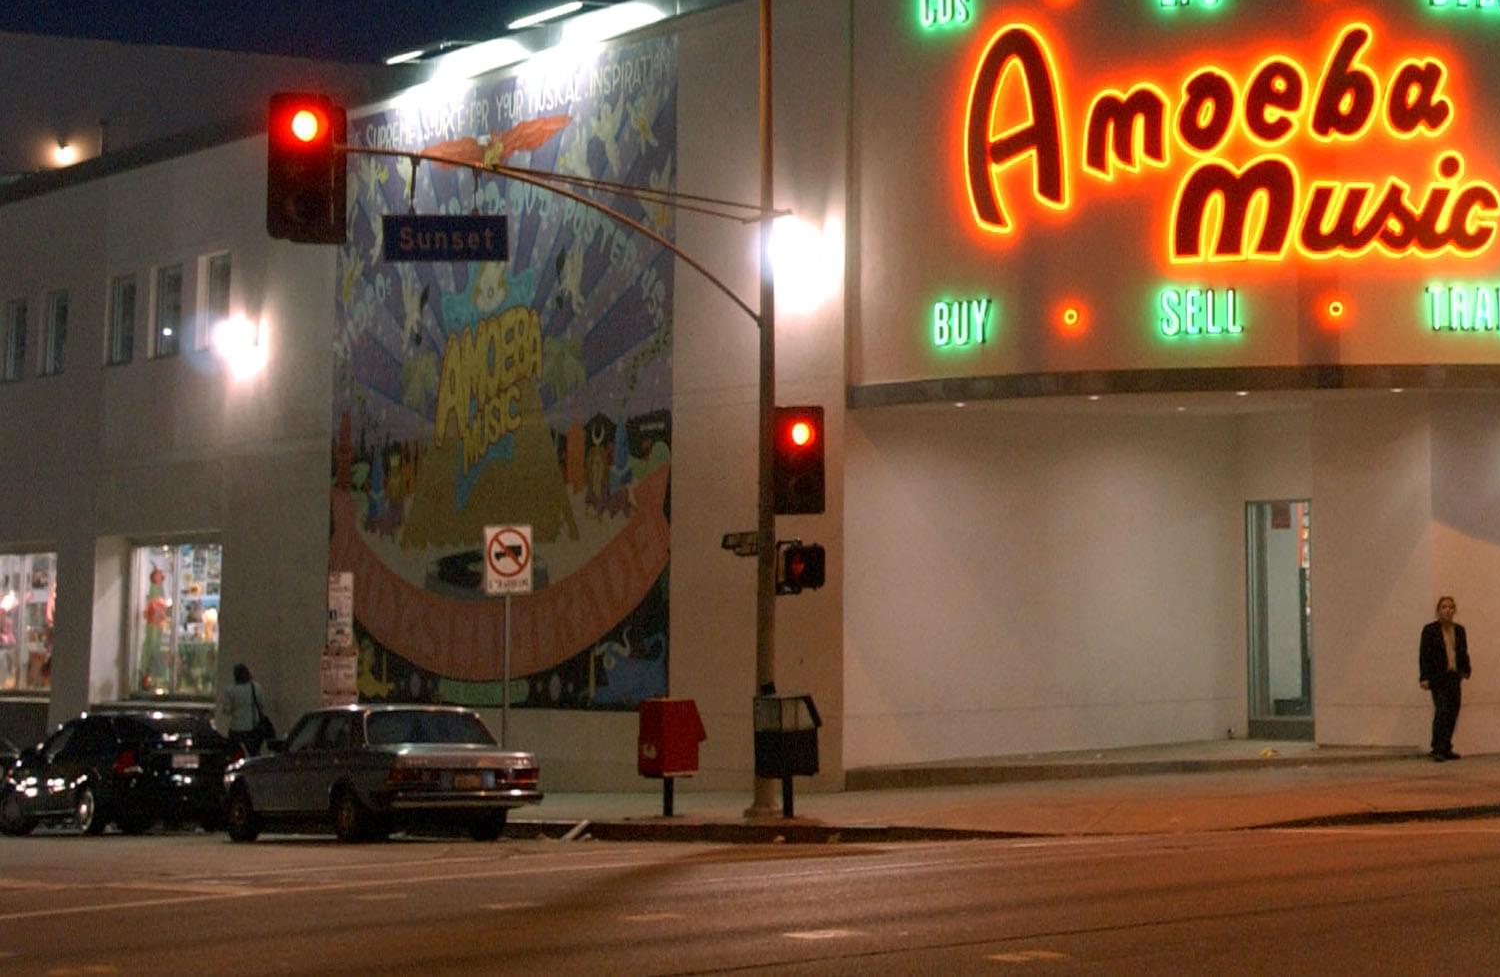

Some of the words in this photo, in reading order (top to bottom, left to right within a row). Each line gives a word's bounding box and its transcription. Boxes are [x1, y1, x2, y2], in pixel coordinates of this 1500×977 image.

[964, 22, 1454, 232] Amoeba
[400, 226, 494, 251] Sunset
[933, 298, 991, 346] BUY
[1160, 287, 1244, 335] SELL
[434, 306, 543, 448] AMOEBA
[461, 385, 521, 477] MUSIC
